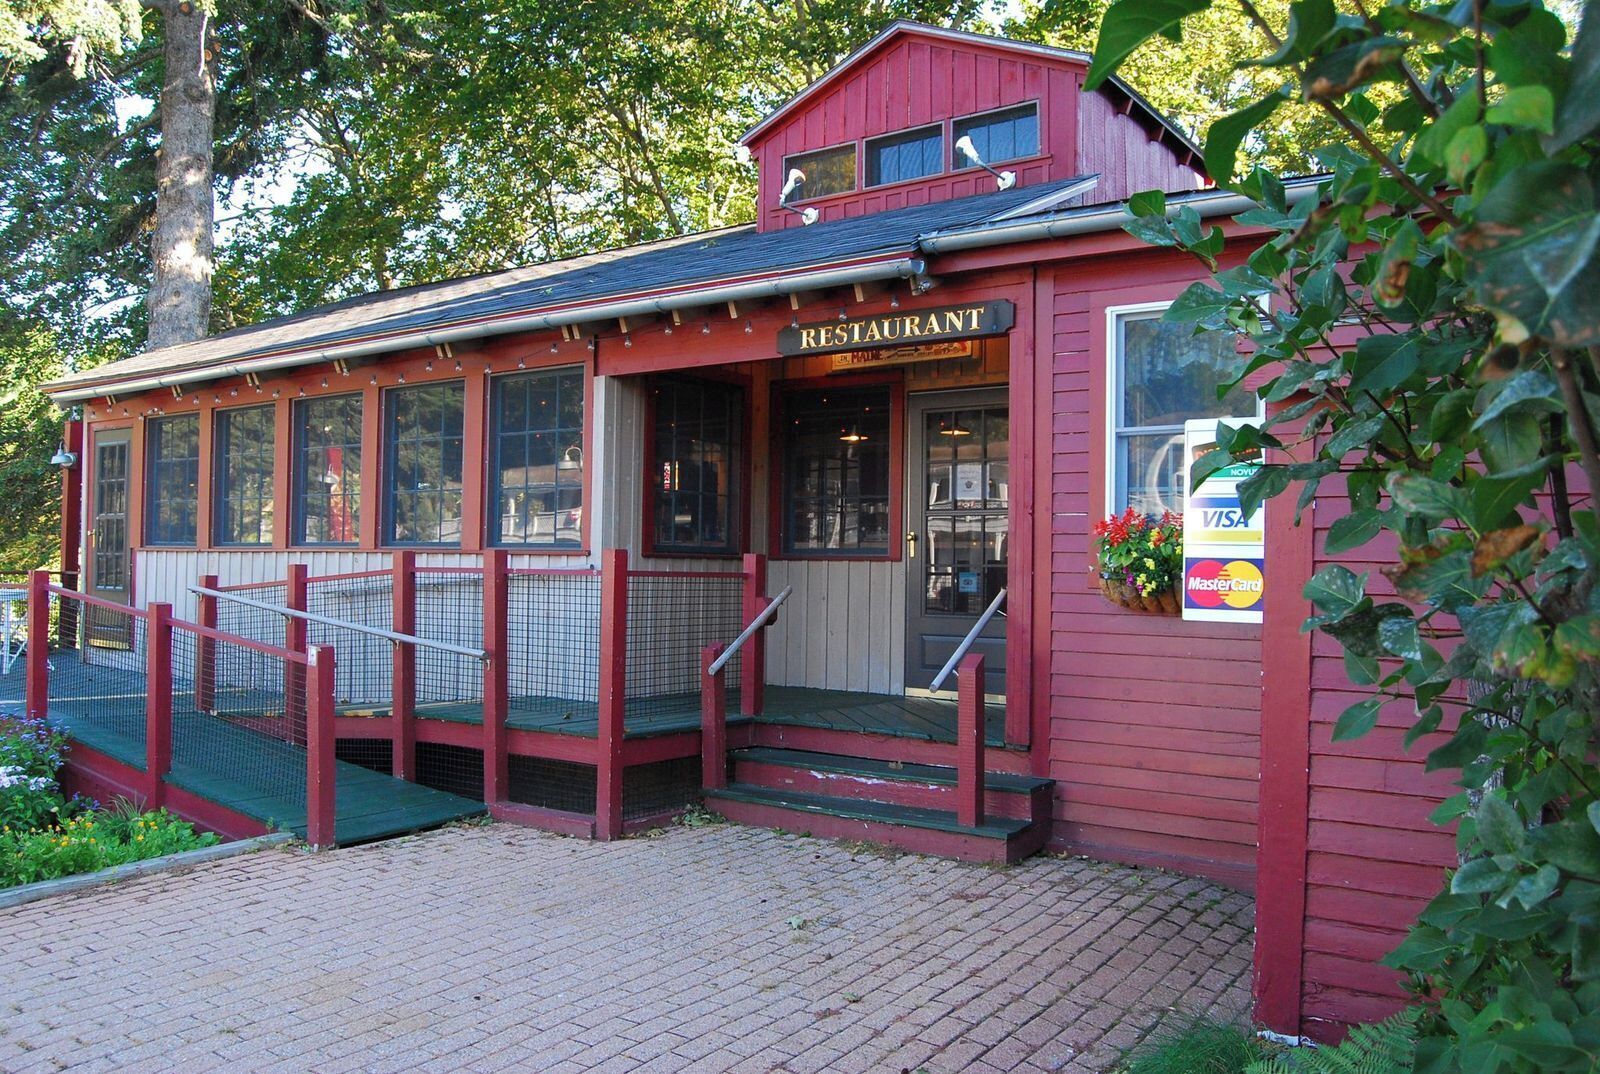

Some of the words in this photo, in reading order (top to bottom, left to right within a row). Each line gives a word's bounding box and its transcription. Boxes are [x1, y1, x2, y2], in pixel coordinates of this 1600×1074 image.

[800, 306, 984, 349] RESTAURANT
[1202, 510, 1249, 528] VISA
[1188, 576, 1261, 592] MasterCard
